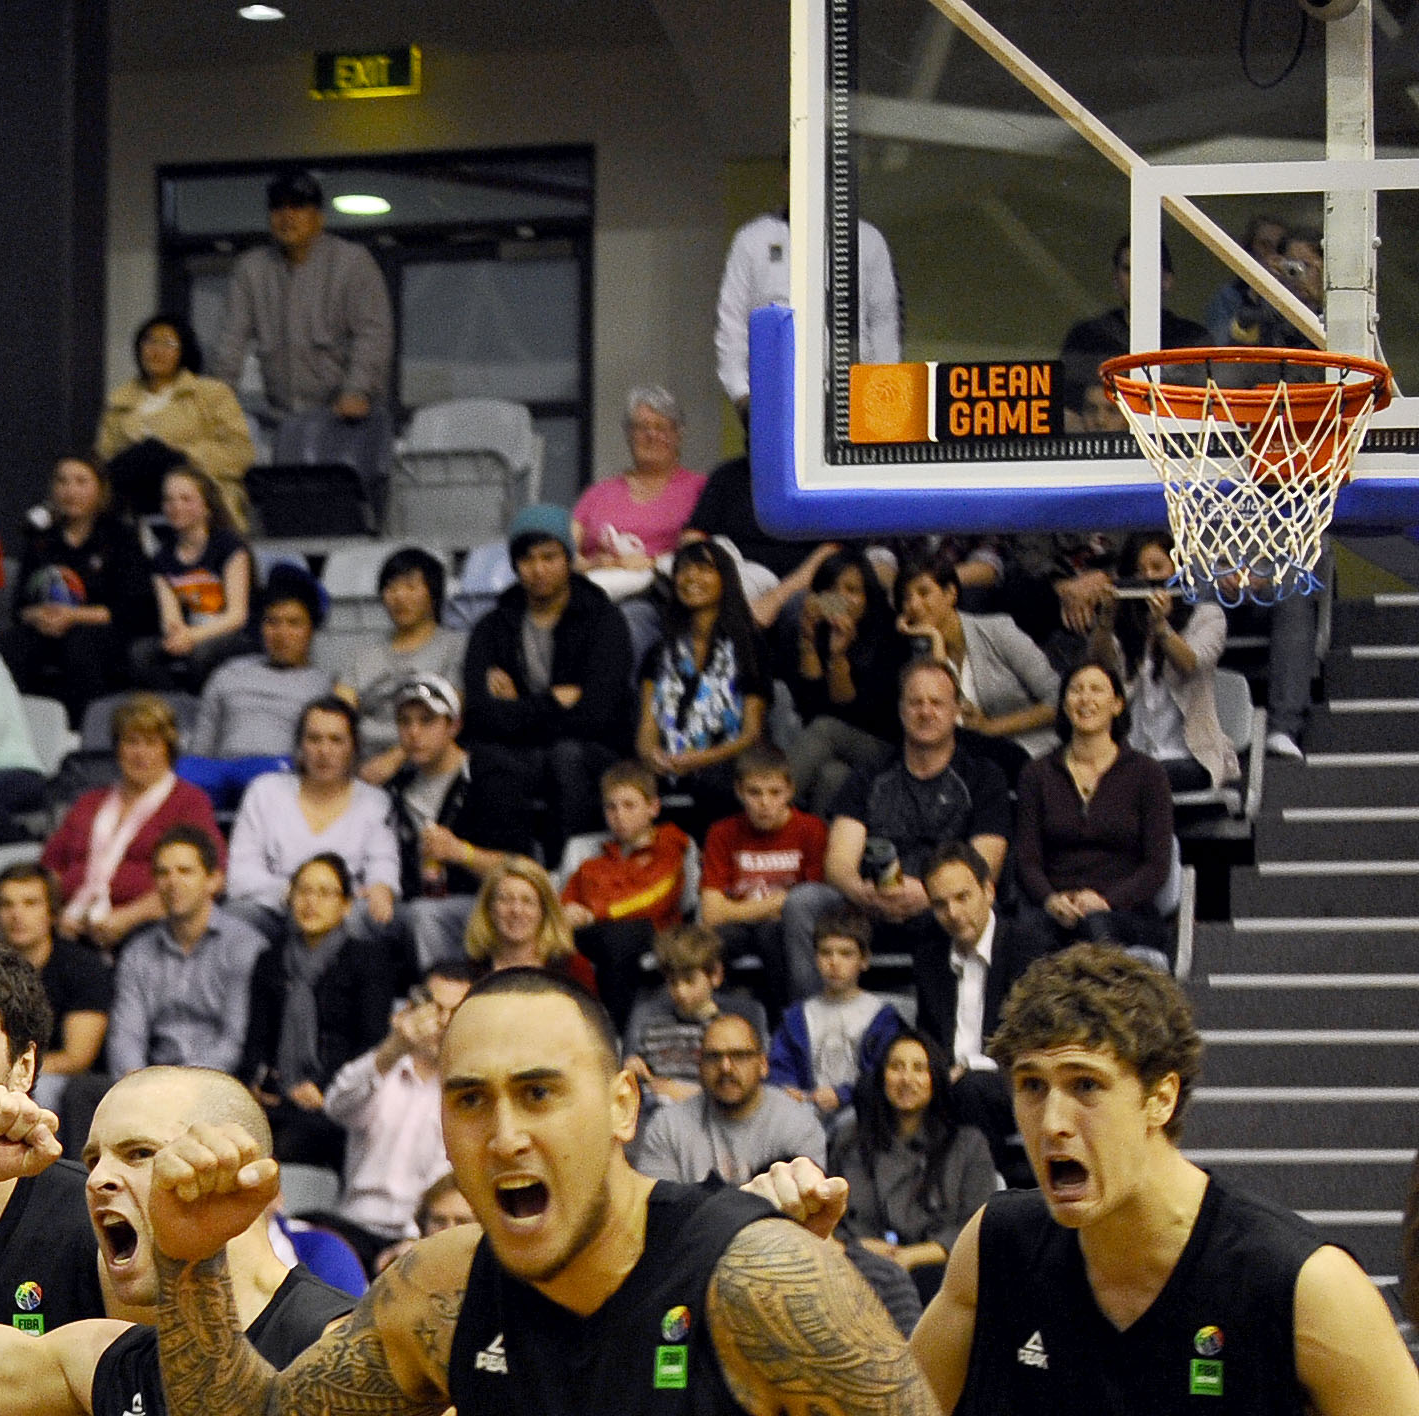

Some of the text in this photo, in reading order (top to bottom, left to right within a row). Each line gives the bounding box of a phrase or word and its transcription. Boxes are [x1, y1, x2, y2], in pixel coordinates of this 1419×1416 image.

[334, 54, 390, 88] EXIT
[948, 365, 1051, 398] CLEAN
[948, 399, 1051, 436] GAME
[18, 1319, 39, 1330] FIBA
